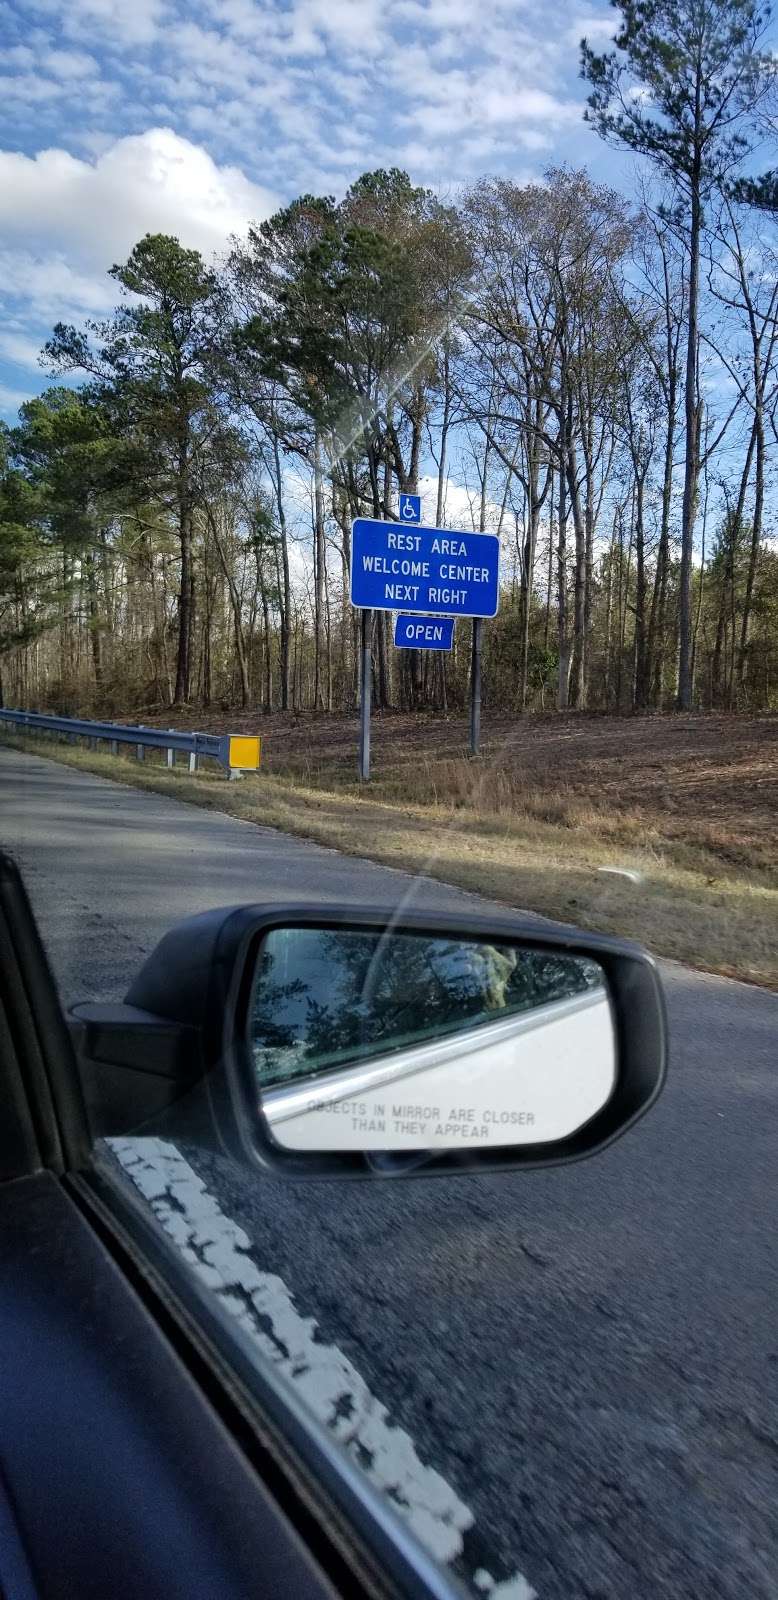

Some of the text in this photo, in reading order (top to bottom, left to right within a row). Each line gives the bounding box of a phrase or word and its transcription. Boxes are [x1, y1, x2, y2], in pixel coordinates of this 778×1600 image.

[387, 533, 468, 557] REST AREA
[362, 556, 490, 583] WELCOME CENTER
[384, 583, 468, 605] NEXT RIGHT
[405, 624, 443, 641] OPEN
[374, 1103, 385, 1117] IN
[392, 1105, 440, 1120] MIRROR
[448, 1108, 476, 1122] ARE
[482, 1110, 536, 1126] CLOSER
[351, 1117, 489, 1138] THAN THEY APPEAR
